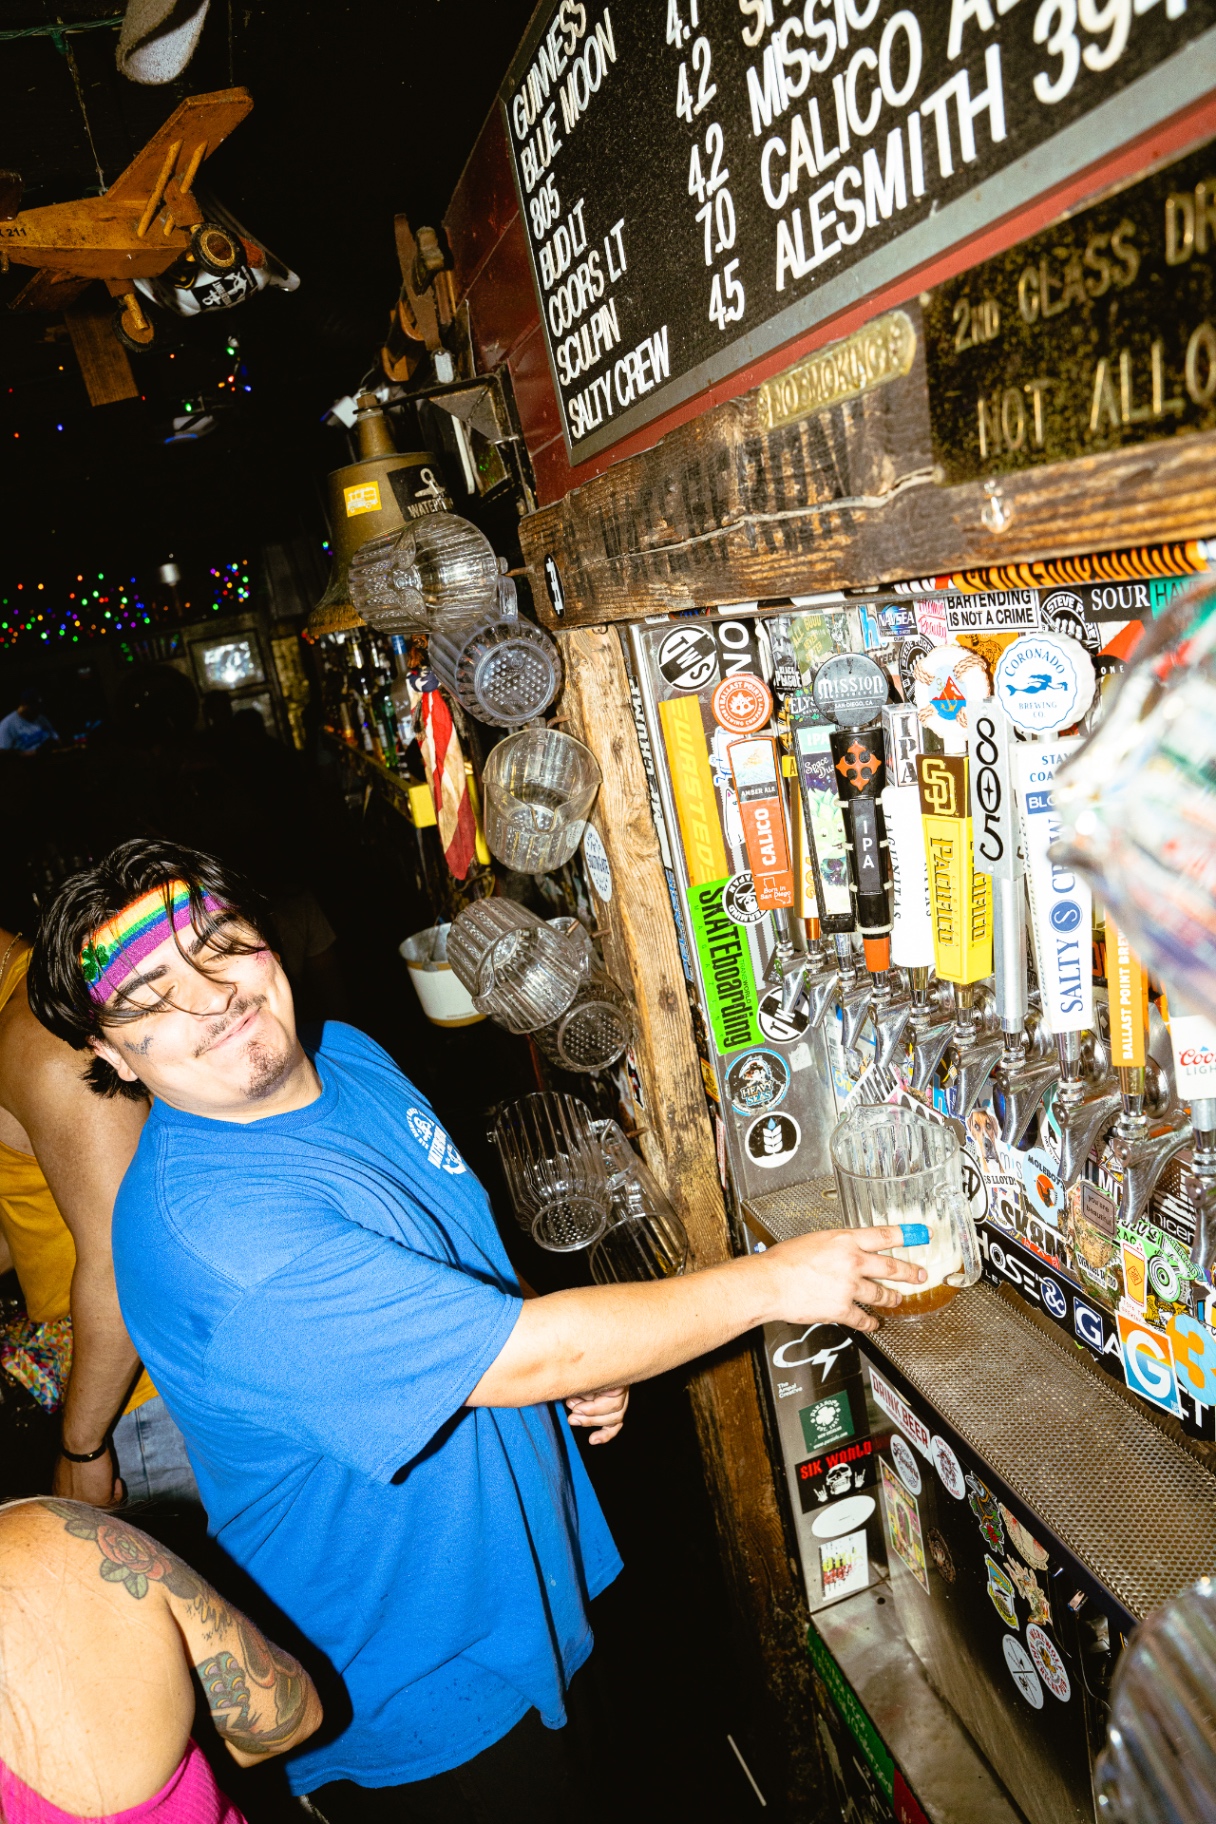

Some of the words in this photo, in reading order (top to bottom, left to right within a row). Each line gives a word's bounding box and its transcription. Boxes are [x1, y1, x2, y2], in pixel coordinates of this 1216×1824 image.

[513, 0, 586, 140] GUINNESS
[520, 102, 563, 193] BLUE
[559, 7, 617, 134] MOON
[761, 9, 922, 210] CALICO
[775, 42, 1007, 292] ALESMITH
[530, 172, 561, 240] 805
[548, 250, 605, 338] COORS
[603, 218, 628, 284] LT
[556, 297, 621, 387] SCULPIN
[568, 370, 615, 439] SALTY
[613, 325, 670, 407] CREW
[877, 611, 916, 628] NAVSEA
[948, 589, 1032, 610] BARTENDING
[949, 612, 960, 627] IS
[962, 610, 984, 627] NOT
[986, 610, 995, 625] A
[996, 607, 1035, 626] CRIME
[1047, 596, 1075, 614] STEVE
[1090, 584, 1151, 612] SOUR
[667, 635, 711, 680] TWS
[1004, 648, 1066, 677] CORONADO
[1019, 701, 1058, 710] BREWING
[740, 785, 763, 797] AMBER
[764, 786, 776, 794] ALE
[976, 717, 1004, 862] 805
[753, 807, 777, 867] CALICO
[862, 820, 875, 869] IPA
[930, 837, 955, 947] PACIFICO
[1056, 938, 1084, 1014] SALTY
[1118, 967, 1132, 1005] POINT
[1120, 1008, 1134, 1060] BALLAST
[741, 1081, 772, 1098] HEAVY
[871, 1373, 900, 1419] DRINK
[901, 1404, 929, 1450] BEER
[800, 1459, 823, 1481] SIK
[825, 1440, 873, 1469] WORLD
